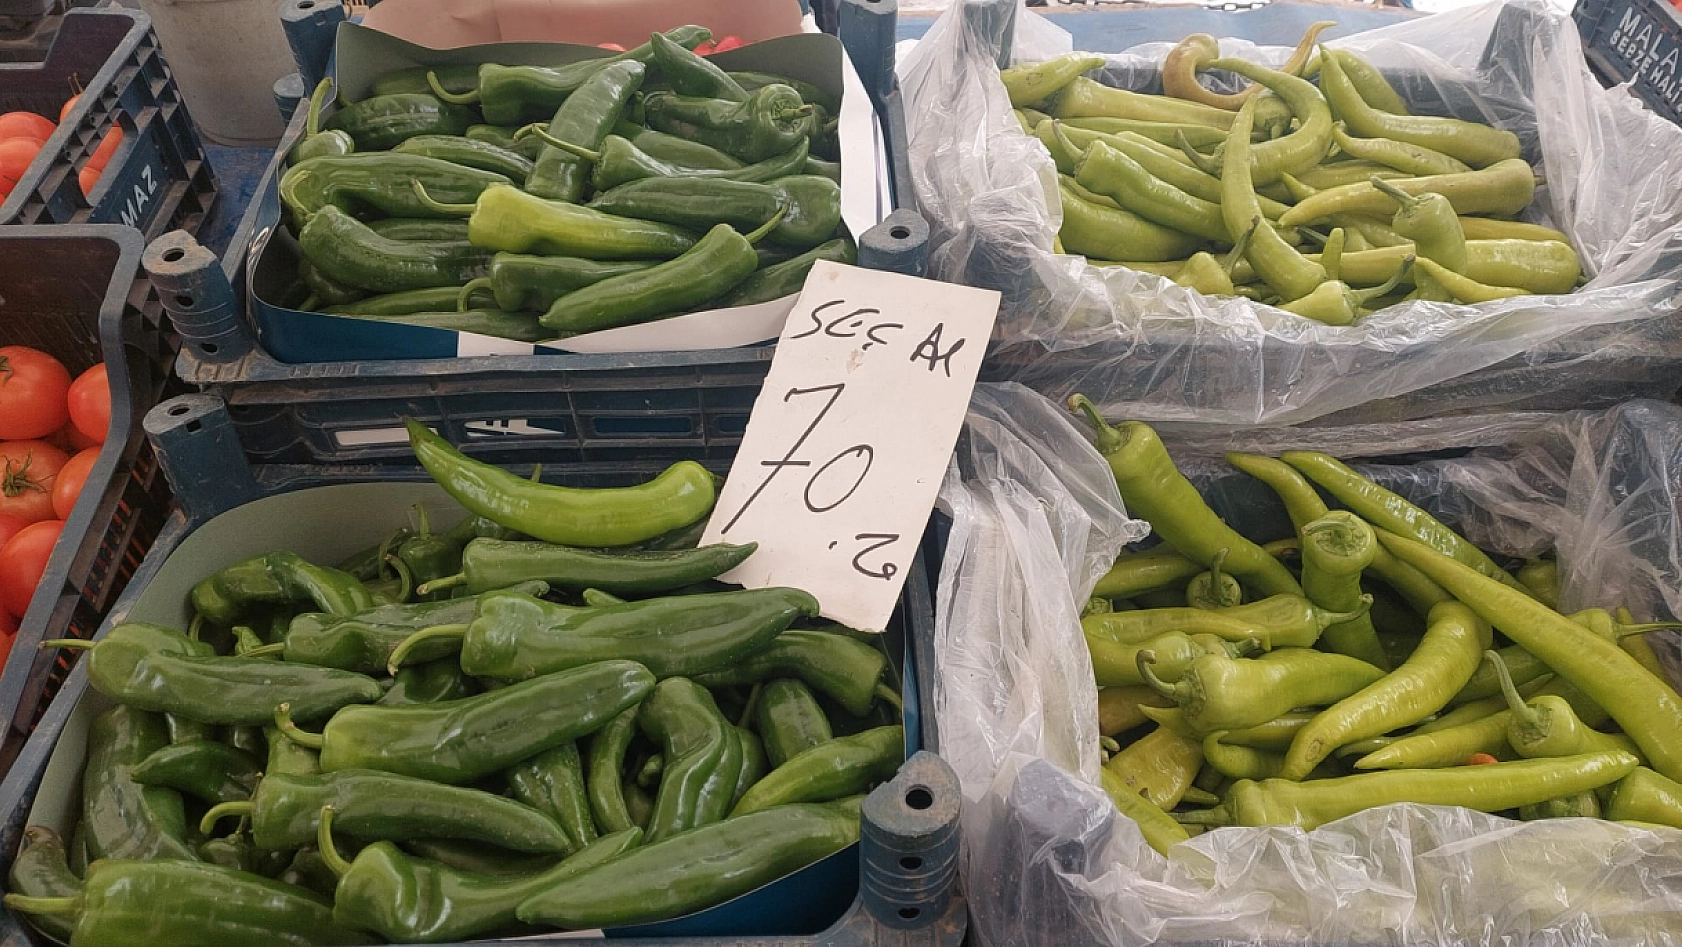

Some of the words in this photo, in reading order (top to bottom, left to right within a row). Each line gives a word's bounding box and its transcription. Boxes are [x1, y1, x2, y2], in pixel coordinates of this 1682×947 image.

[1610, 29, 1652, 74] SEBZE
[1619, 7, 1682, 84] MALA
[787, 300, 904, 350] SEÇ
[721, 383, 874, 534] 70
